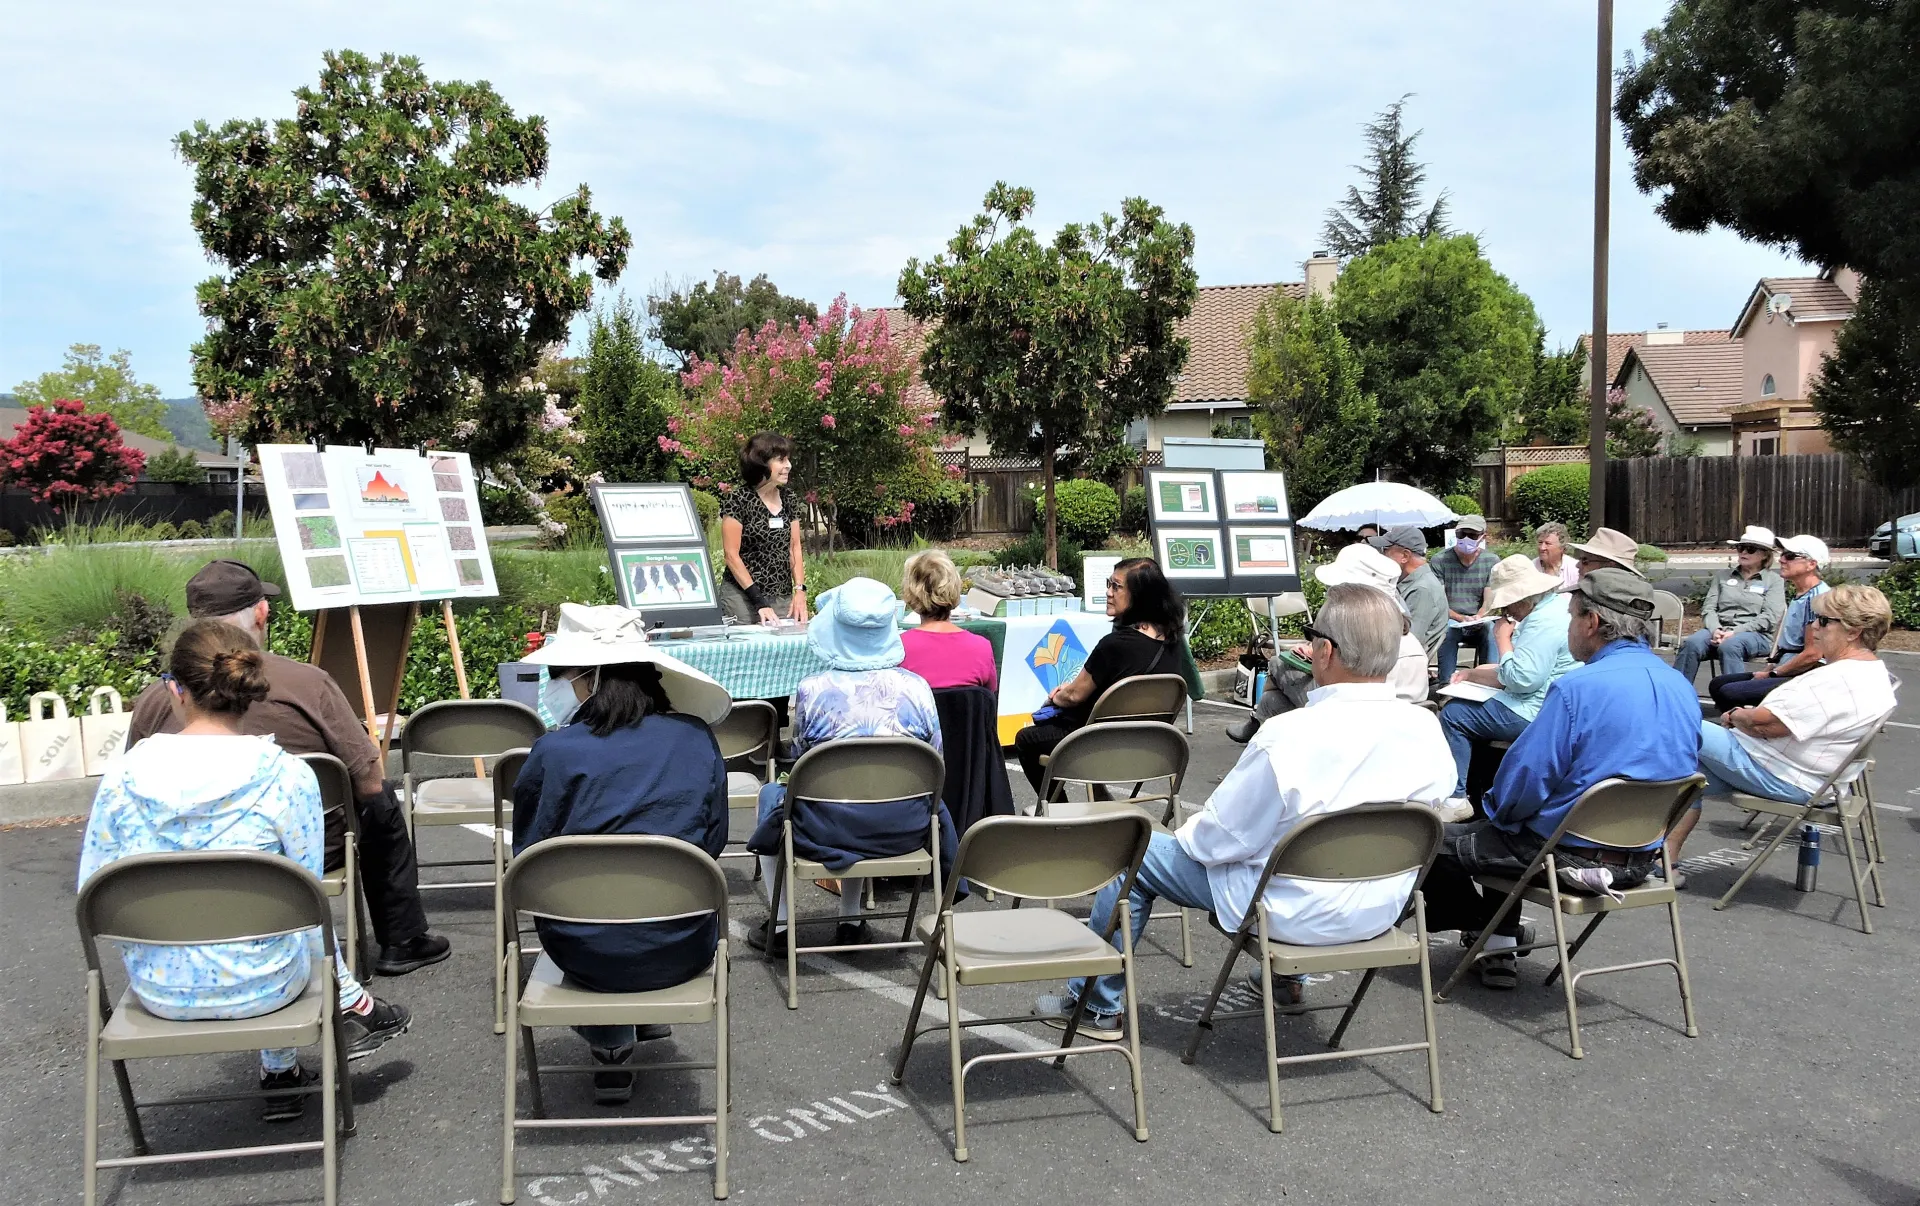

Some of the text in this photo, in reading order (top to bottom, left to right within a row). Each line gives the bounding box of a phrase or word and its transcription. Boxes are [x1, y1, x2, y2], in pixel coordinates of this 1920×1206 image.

[40, 735, 70, 766] SOIL
[97, 729, 126, 761] SOIL
[529, 1081, 909, 1206] CARS ONLY
